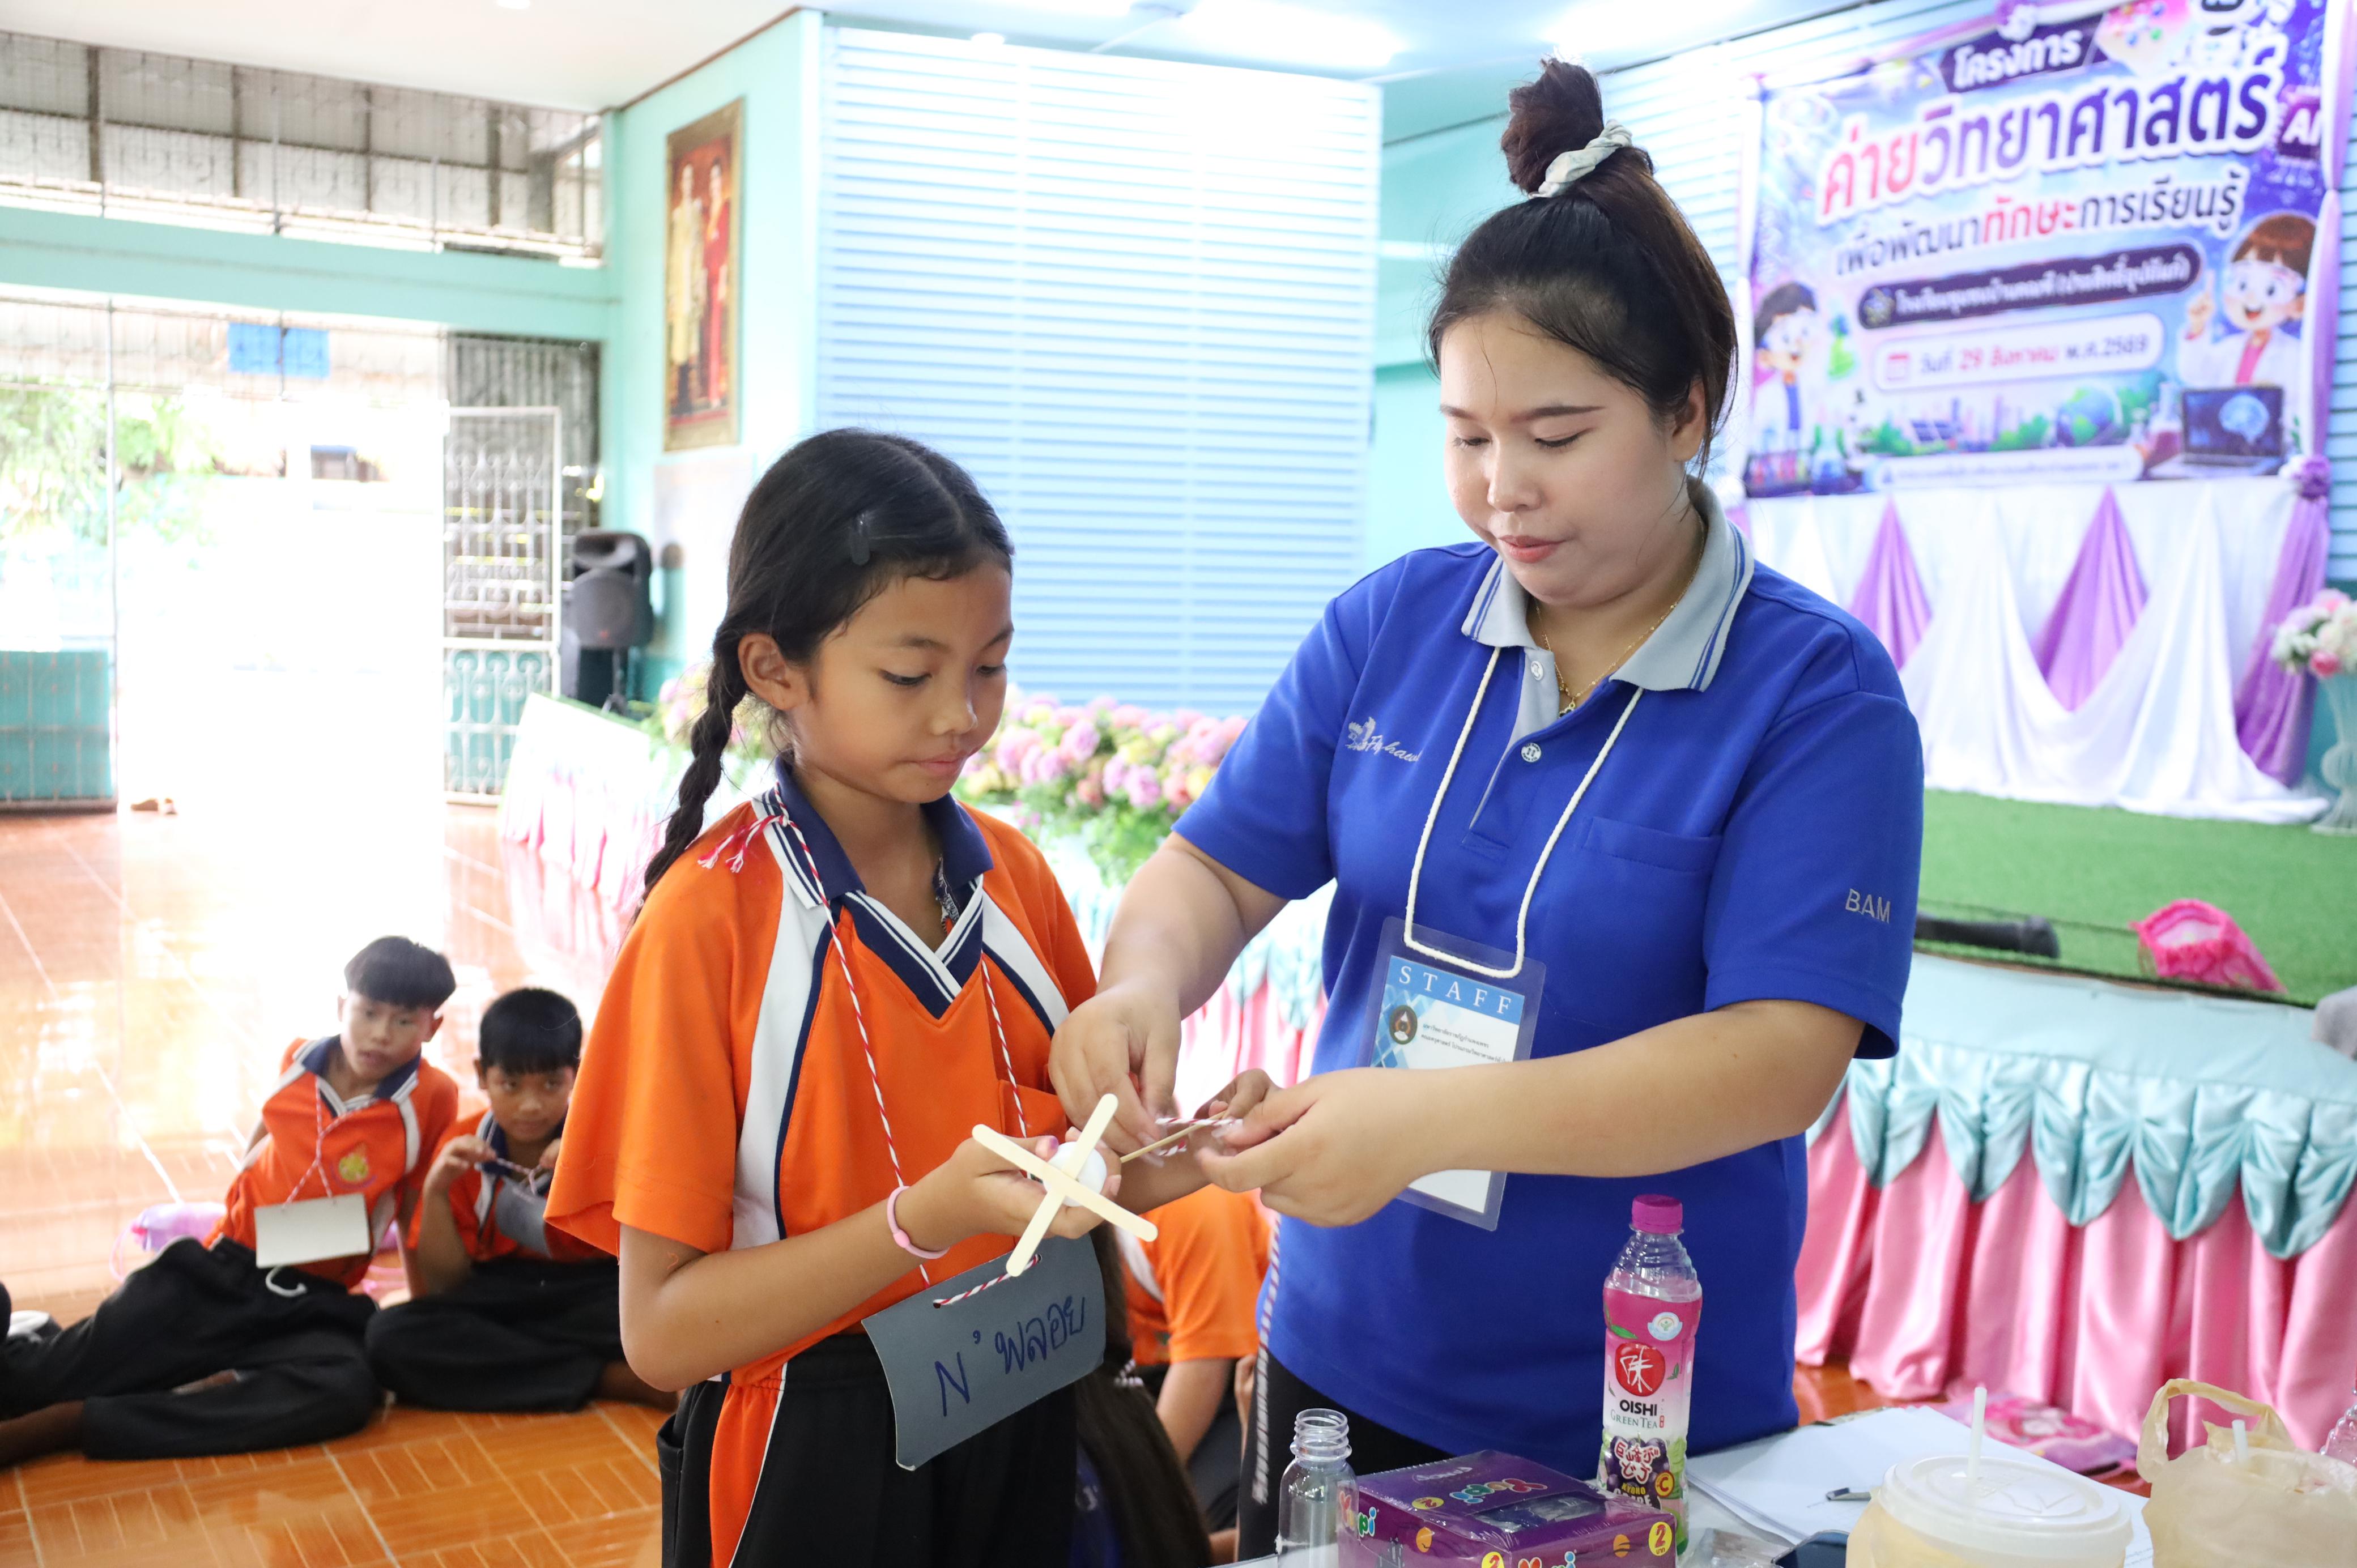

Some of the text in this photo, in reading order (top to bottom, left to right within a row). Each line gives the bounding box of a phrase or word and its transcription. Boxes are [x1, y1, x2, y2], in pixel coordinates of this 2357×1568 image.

[1953, 29, 2084, 88] โครงการ
[1822, 45, 2277, 215] ค่ายวิทยาศาสตร์
[1835, 171, 2242, 276] เพื่อพัฒนาทักษะการเรียนรู้
[1845, 888, 1891, 924] BAM
[1399, 966, 1512, 1014] STAFF
[995, 1296, 1085, 1374] พลอย
[1619, 1399, 1657, 1416] OISHI
[1655, 1524, 1666, 1549] 2
